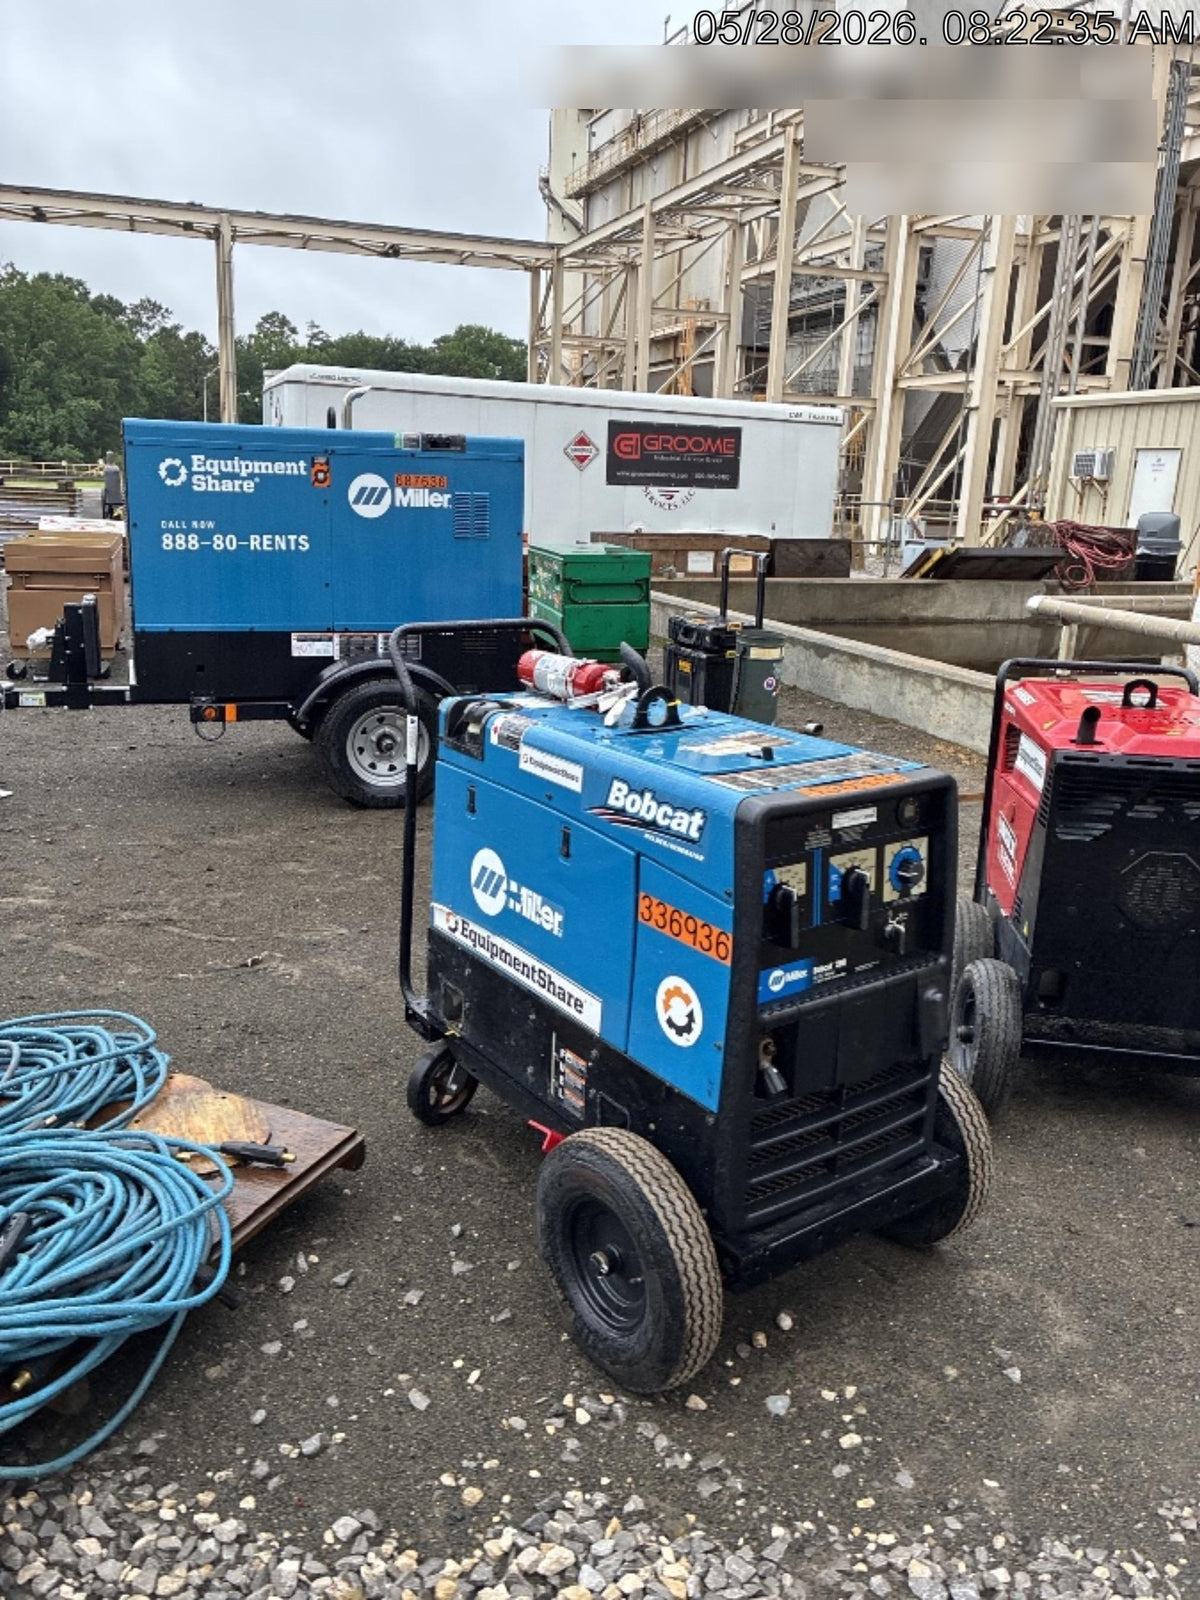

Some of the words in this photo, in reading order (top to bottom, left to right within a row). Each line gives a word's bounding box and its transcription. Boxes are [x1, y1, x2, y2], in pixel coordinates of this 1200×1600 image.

[643, 434, 736, 455] GROOME
[190, 454, 308, 477] Equipment
[395, 487, 452, 509] Miller
[160, 520, 188, 530] CALL
[191, 520, 216, 530] NOW
[161, 533, 310, 551] 888-80-RENTS
[607, 778, 706, 841] Bobcat
[505, 879, 564, 939] Miller
[639, 893, 732, 962] 336936
[460, 919, 584, 1015] EquipmentShare
